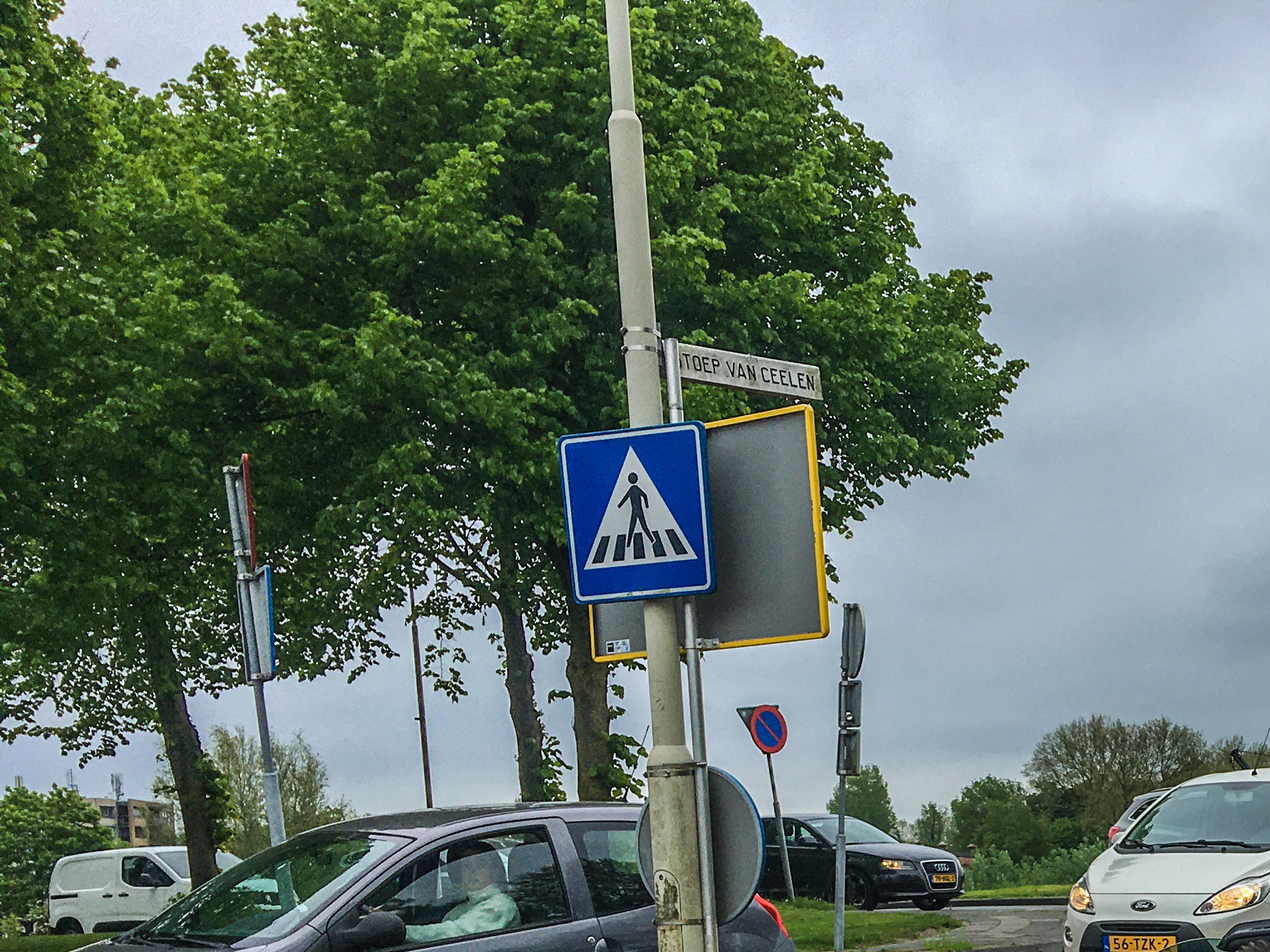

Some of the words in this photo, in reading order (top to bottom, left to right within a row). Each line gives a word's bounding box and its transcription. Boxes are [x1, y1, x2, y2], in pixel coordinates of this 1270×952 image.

[679, 353, 720, 374] TOEP
[726, 361, 757, 381] VAN
[761, 367, 816, 391] CEELEN
[1113, 937, 1170, 951] 56-TZK-2
